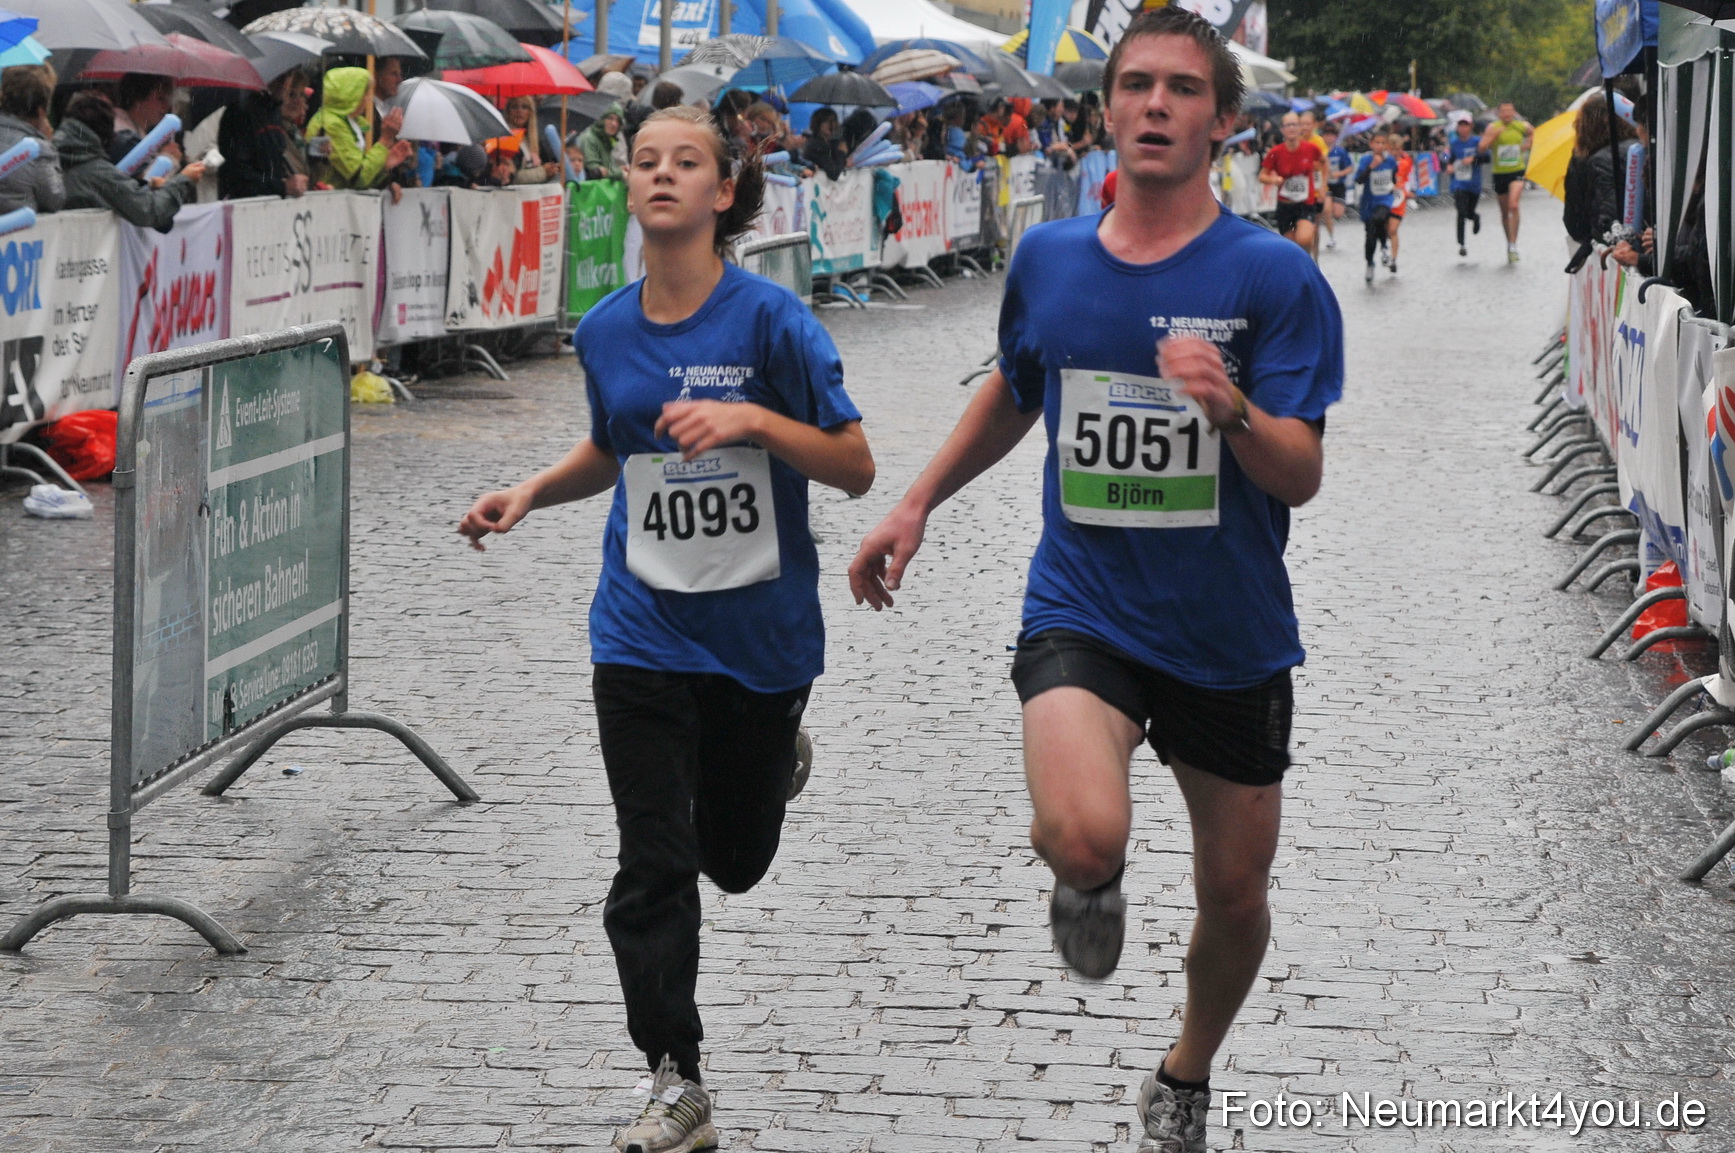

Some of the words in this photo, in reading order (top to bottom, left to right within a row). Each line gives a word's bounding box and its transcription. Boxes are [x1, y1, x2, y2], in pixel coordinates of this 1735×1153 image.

[1624, 152, 1640, 225] ReiseCenter
[246, 241, 291, 278] RECHTS
[1149, 316, 1170, 329] 12.
[1171, 316, 1248, 331] NEUMARKTER
[1168, 328, 1234, 342] STADTLAUF
[668, 366, 685, 378] 12.
[683, 376, 745, 387] STADTLAUF
[236, 388, 300, 428] Event-Leit-Systeme
[1108, 382, 1173, 403] BOCK
[1073, 411, 1199, 472] 5051
[663, 458, 722, 476] BOCK
[1106, 481, 1165, 509] Björn
[213, 508, 236, 559] Fun
[239, 499, 249, 550] &
[251, 488, 288, 546] Action
[290, 481, 301, 530] in
[643, 483, 760, 542] 4093
[212, 576, 262, 637] sicheren
[264, 548, 310, 613] Bahnen!
